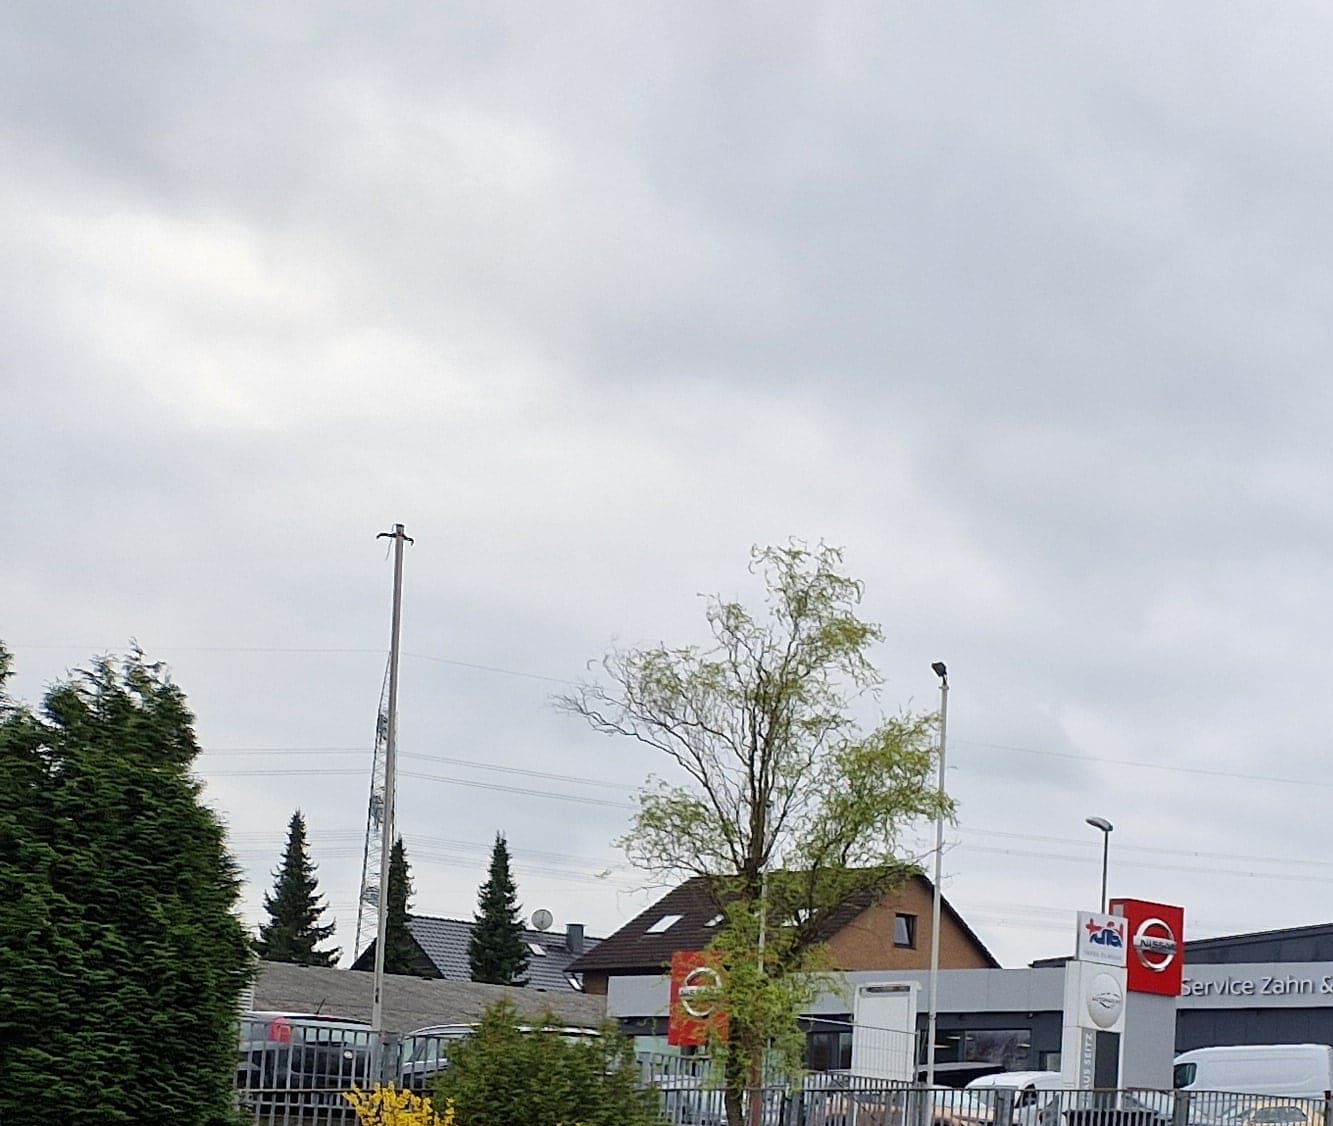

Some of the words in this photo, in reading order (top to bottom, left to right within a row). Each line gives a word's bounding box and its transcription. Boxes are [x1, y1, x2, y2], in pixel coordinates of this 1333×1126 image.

[1139, 938, 1176, 950] NISSAN
[1180, 976, 1254, 996] Service
[1260, 973, 1313, 995] Zahn
[1083, 1032, 1093, 1065] SEITZ
